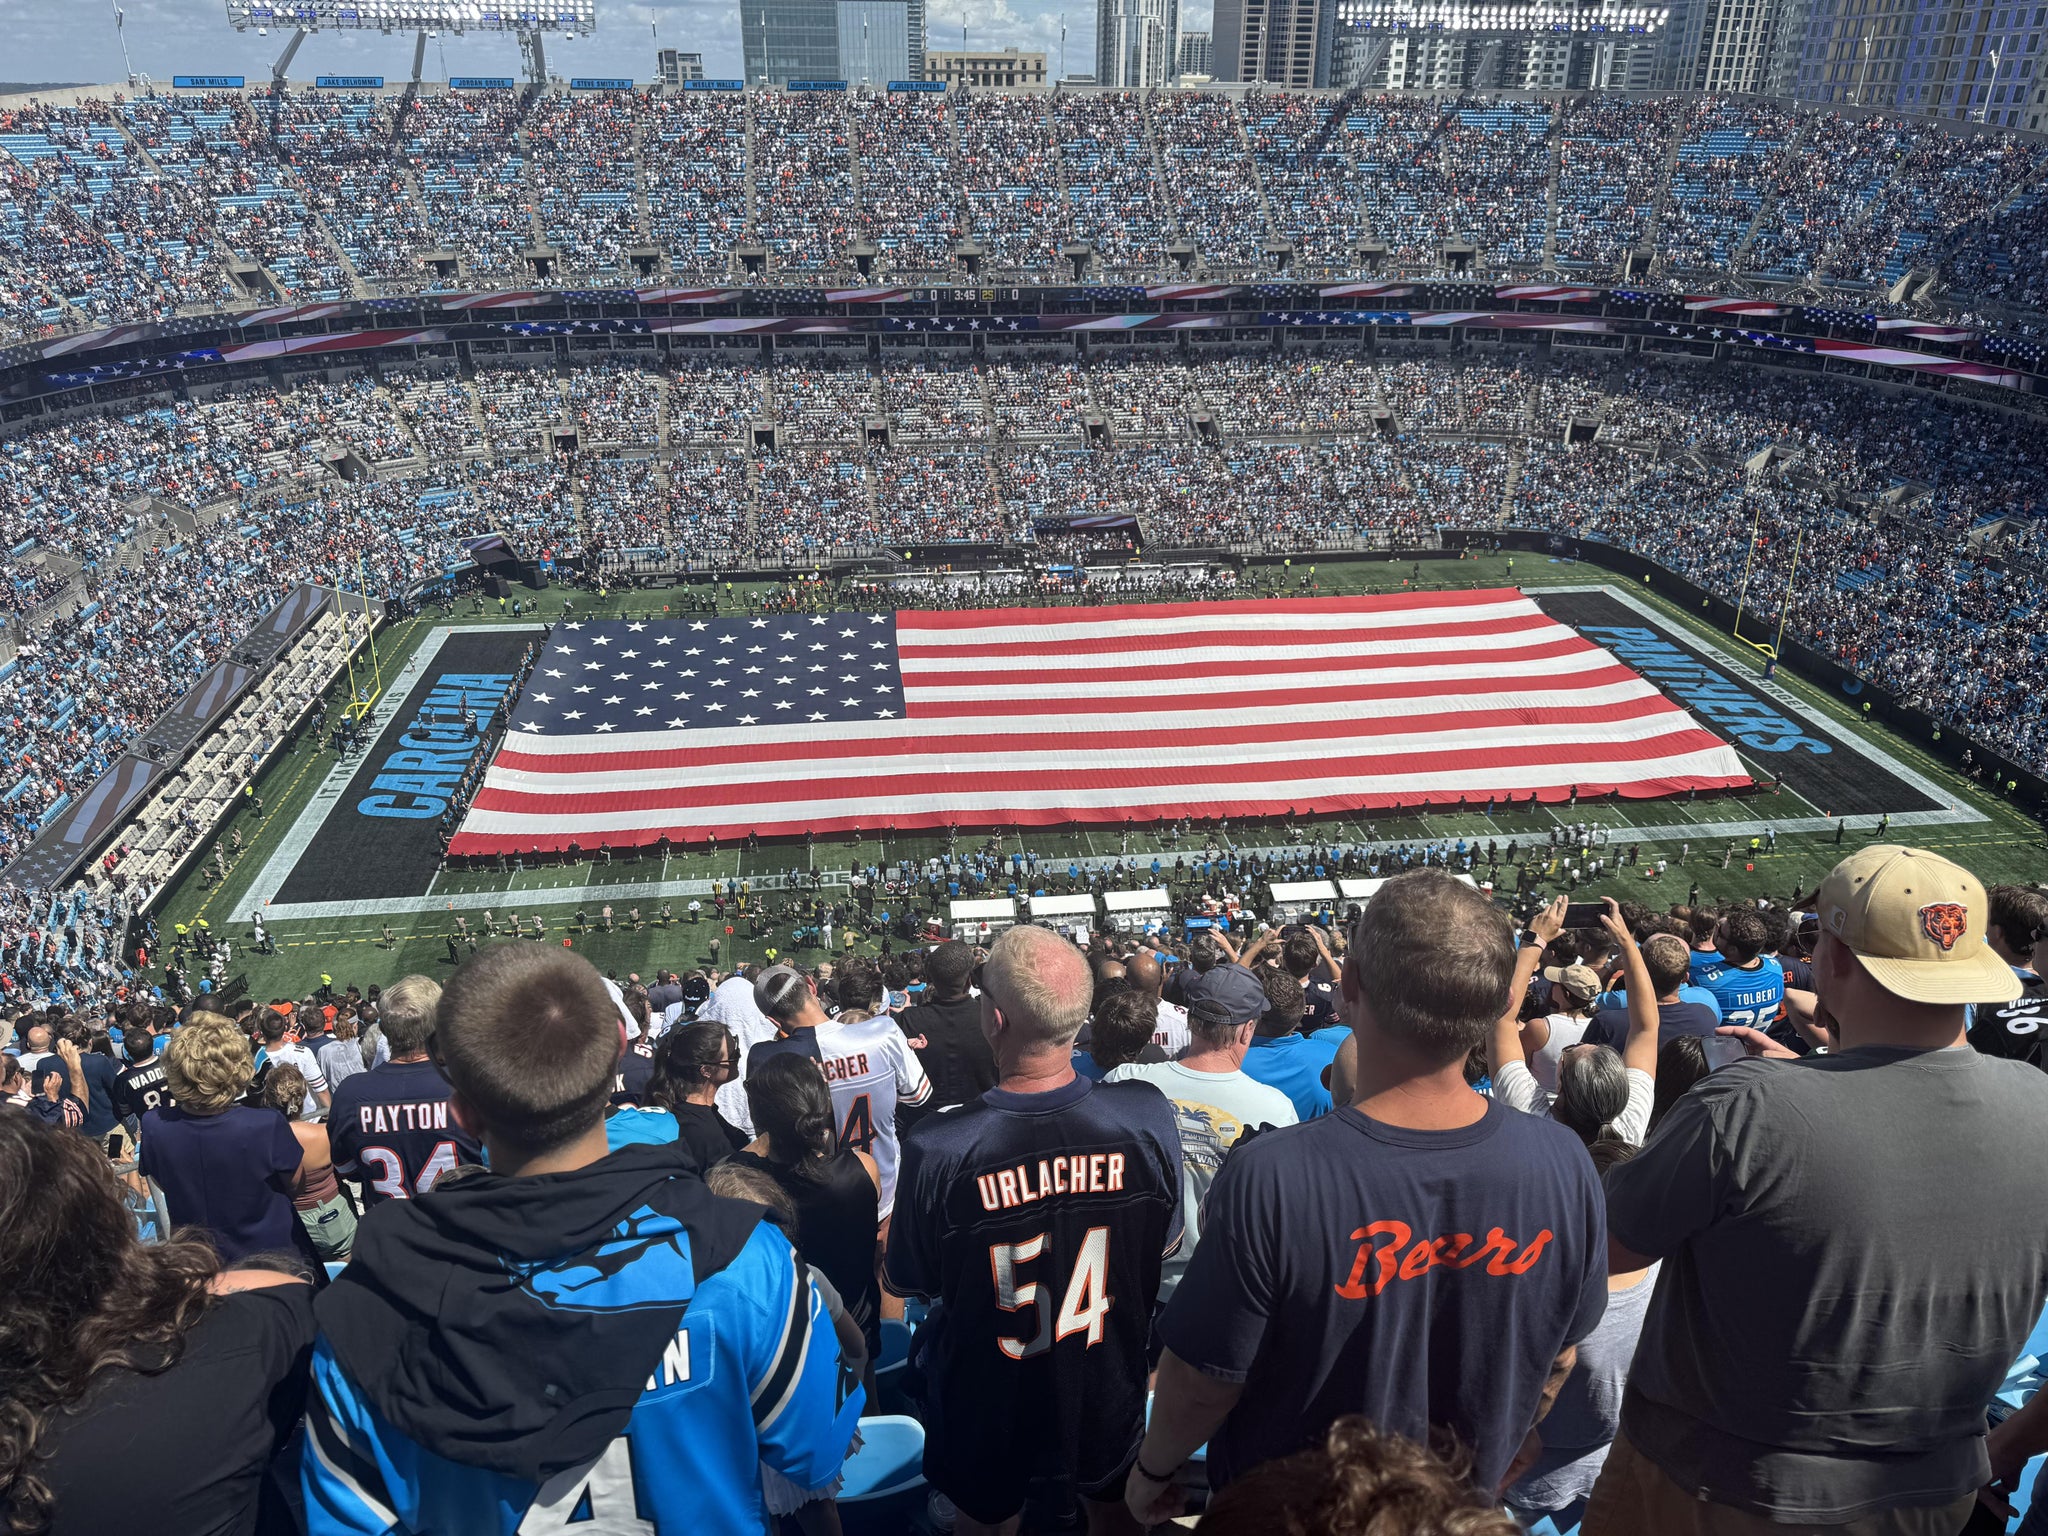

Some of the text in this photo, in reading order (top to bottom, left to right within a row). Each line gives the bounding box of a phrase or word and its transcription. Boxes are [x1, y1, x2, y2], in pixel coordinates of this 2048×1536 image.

[208, 78, 229, 86] MILLS
[954, 289, 976, 301] 3:45
[1705, 650, 1758, 678] NEVER
[1578, 625, 1833, 754] PANTHERS
[357, 674, 515, 819] CAROLINA
[1736, 987, 1777, 1006] TOLBERT
[128, 1066, 168, 1091] WADD
[824, 1052, 869, 1081] CHER
[360, 1101, 448, 1134] PAYTON
[360, 1140, 459, 1200] 34
[976, 1152, 1126, 1212] URLACHER
[1333, 1219, 1554, 1300] Bears
[988, 1225, 1116, 1361] 54
